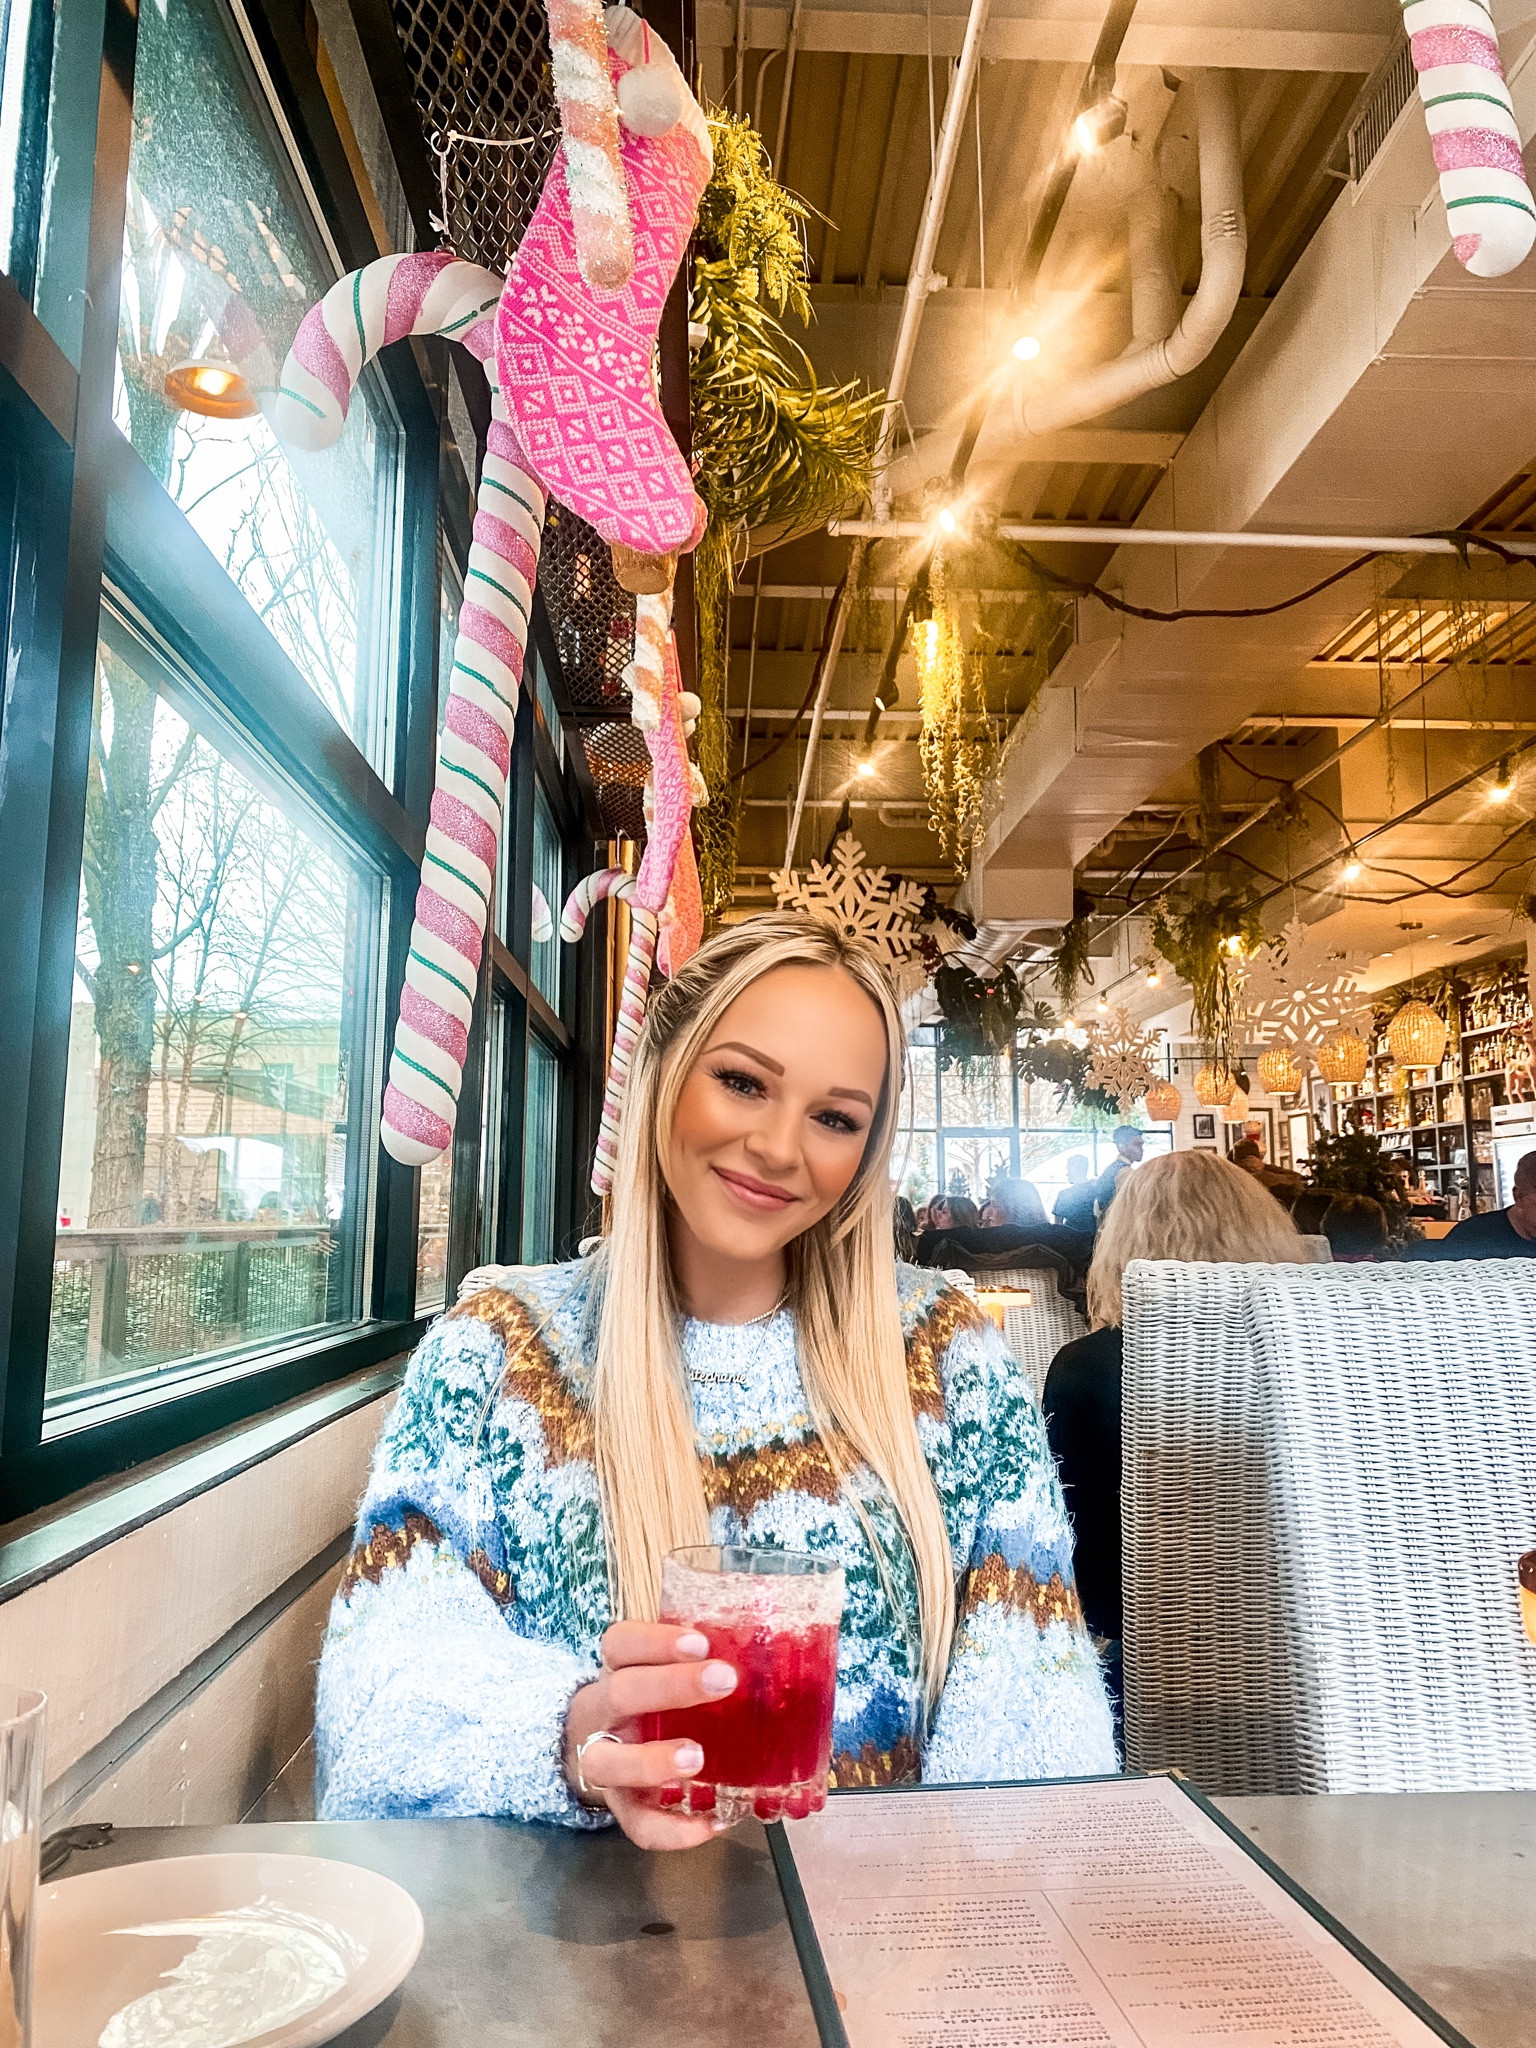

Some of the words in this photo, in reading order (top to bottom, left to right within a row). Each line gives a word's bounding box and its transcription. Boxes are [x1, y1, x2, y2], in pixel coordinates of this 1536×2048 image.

[1294, 1994, 1352, 2002] PERI-PERI
[1236, 2009, 1320, 2019] CAULIFLOWER
[1341, 2022, 1381, 2030] BAKED
[1063, 2035, 1110, 2043] SESAME
[1292, 2036, 1345, 2044] BILTONG
[1350, 2032, 1391, 2040] HOUSE
